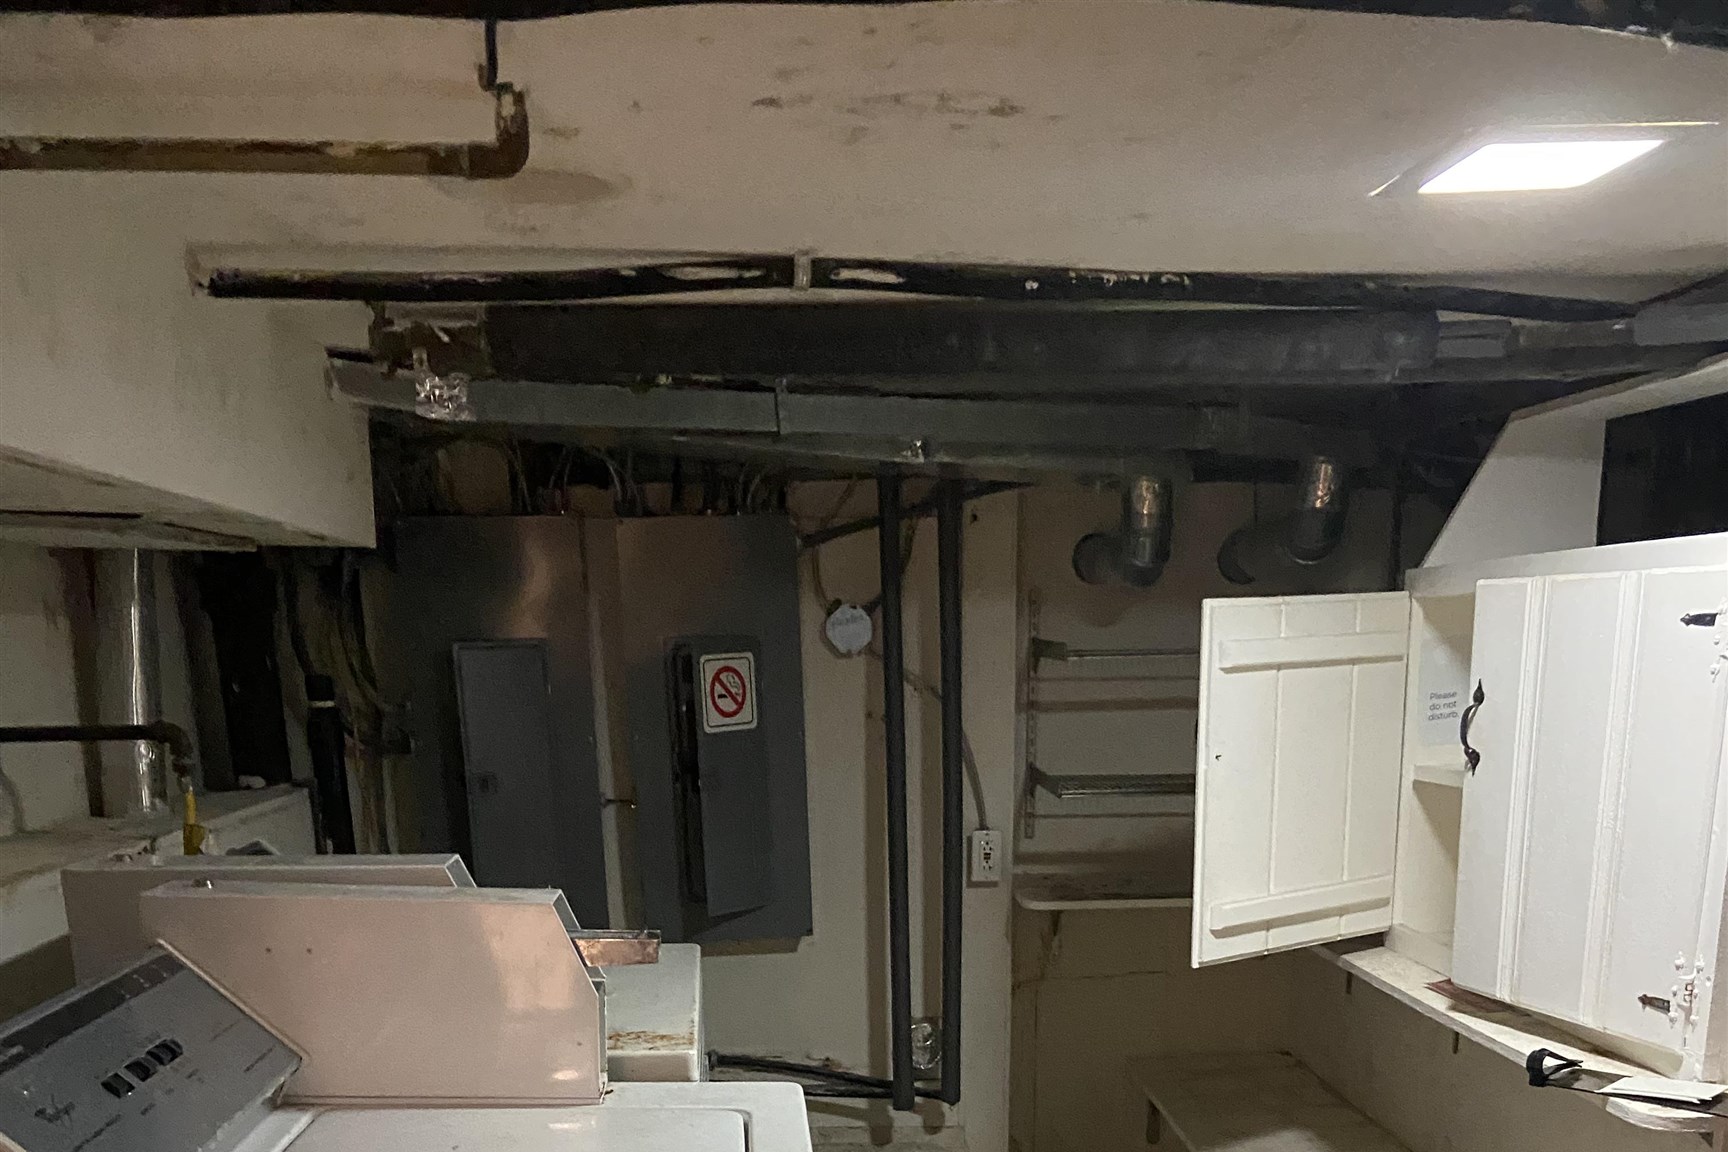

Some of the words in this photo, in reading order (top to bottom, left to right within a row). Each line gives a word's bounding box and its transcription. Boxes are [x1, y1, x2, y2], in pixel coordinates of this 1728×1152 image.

[1430, 692, 1457, 700] Please
[1429, 703, 1441, 711] do
[1443, 701, 1457, 709] not
